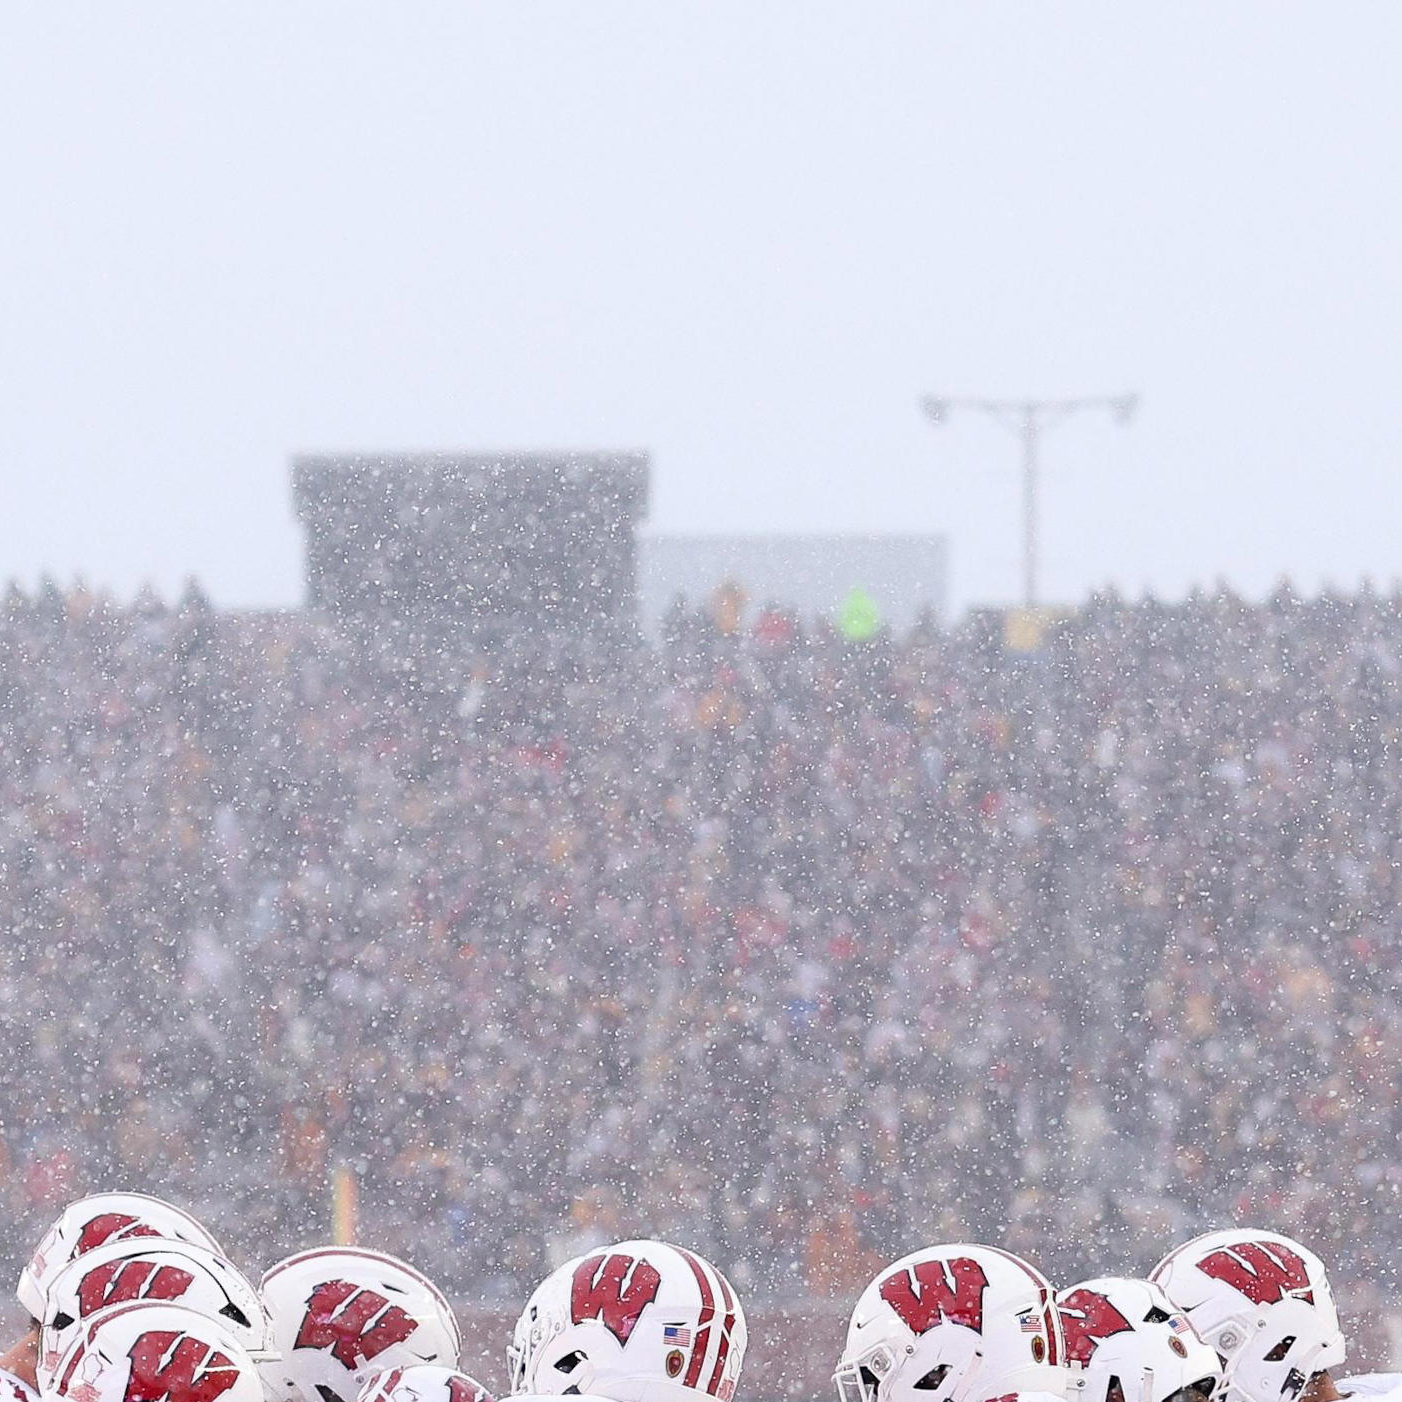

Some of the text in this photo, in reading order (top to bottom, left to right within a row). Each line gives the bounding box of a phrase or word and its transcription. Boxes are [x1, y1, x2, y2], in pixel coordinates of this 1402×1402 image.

[571, 1254, 662, 1346] W
[879, 1257, 990, 1334] W
[1196, 1240, 1317, 1305] W
[292, 1278, 419, 1371] W
